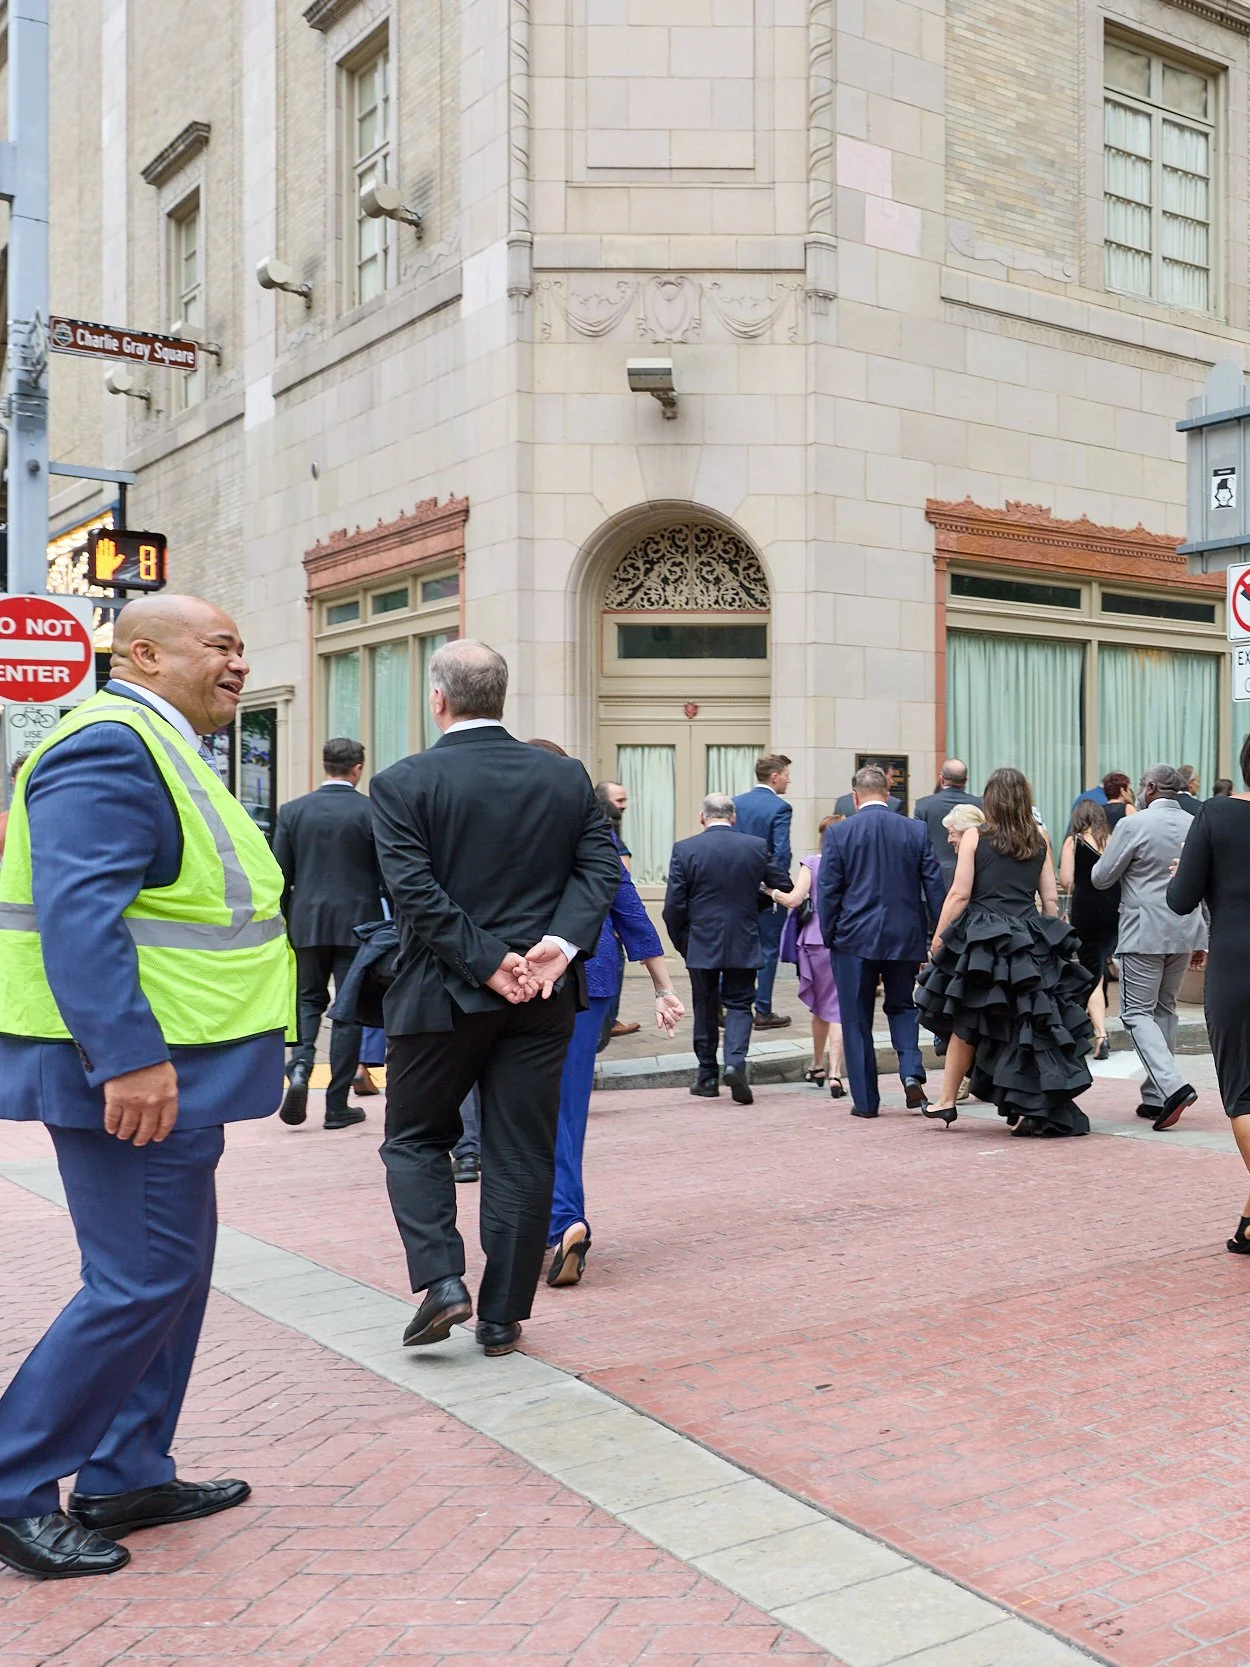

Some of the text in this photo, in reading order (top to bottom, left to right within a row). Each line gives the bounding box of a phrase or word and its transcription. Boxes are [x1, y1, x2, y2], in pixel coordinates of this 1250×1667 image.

[75, 328, 120, 351] Charlie
[122, 336, 151, 362] Gray
[153, 342, 195, 364] Square
[139, 545, 157, 580] 8
[25, 618, 77, 637] NOT
